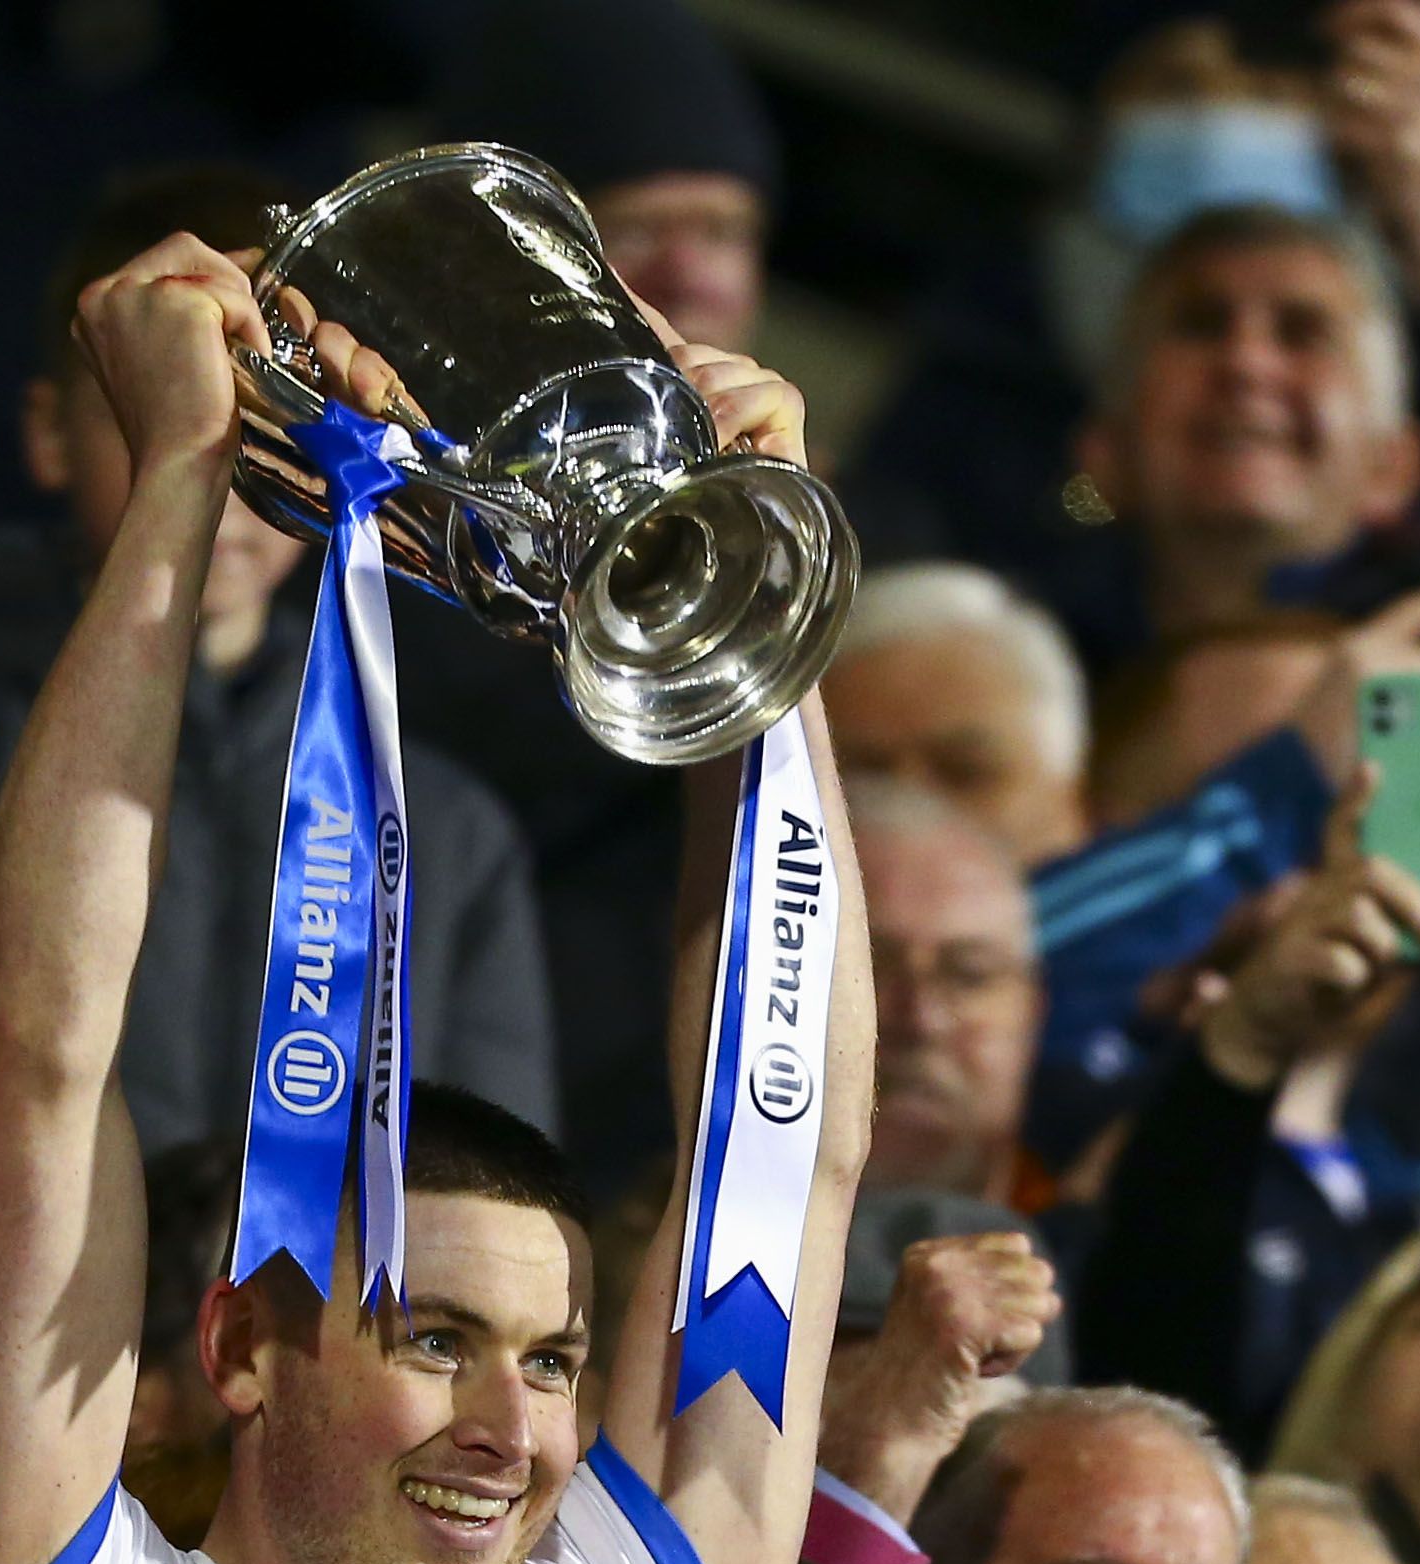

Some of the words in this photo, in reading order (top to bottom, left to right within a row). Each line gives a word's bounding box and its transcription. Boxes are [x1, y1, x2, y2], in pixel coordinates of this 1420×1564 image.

[290, 796, 353, 1017] Allianz
[767, 809, 824, 1027] Allianz
[372, 911, 397, 1132] Allianz
